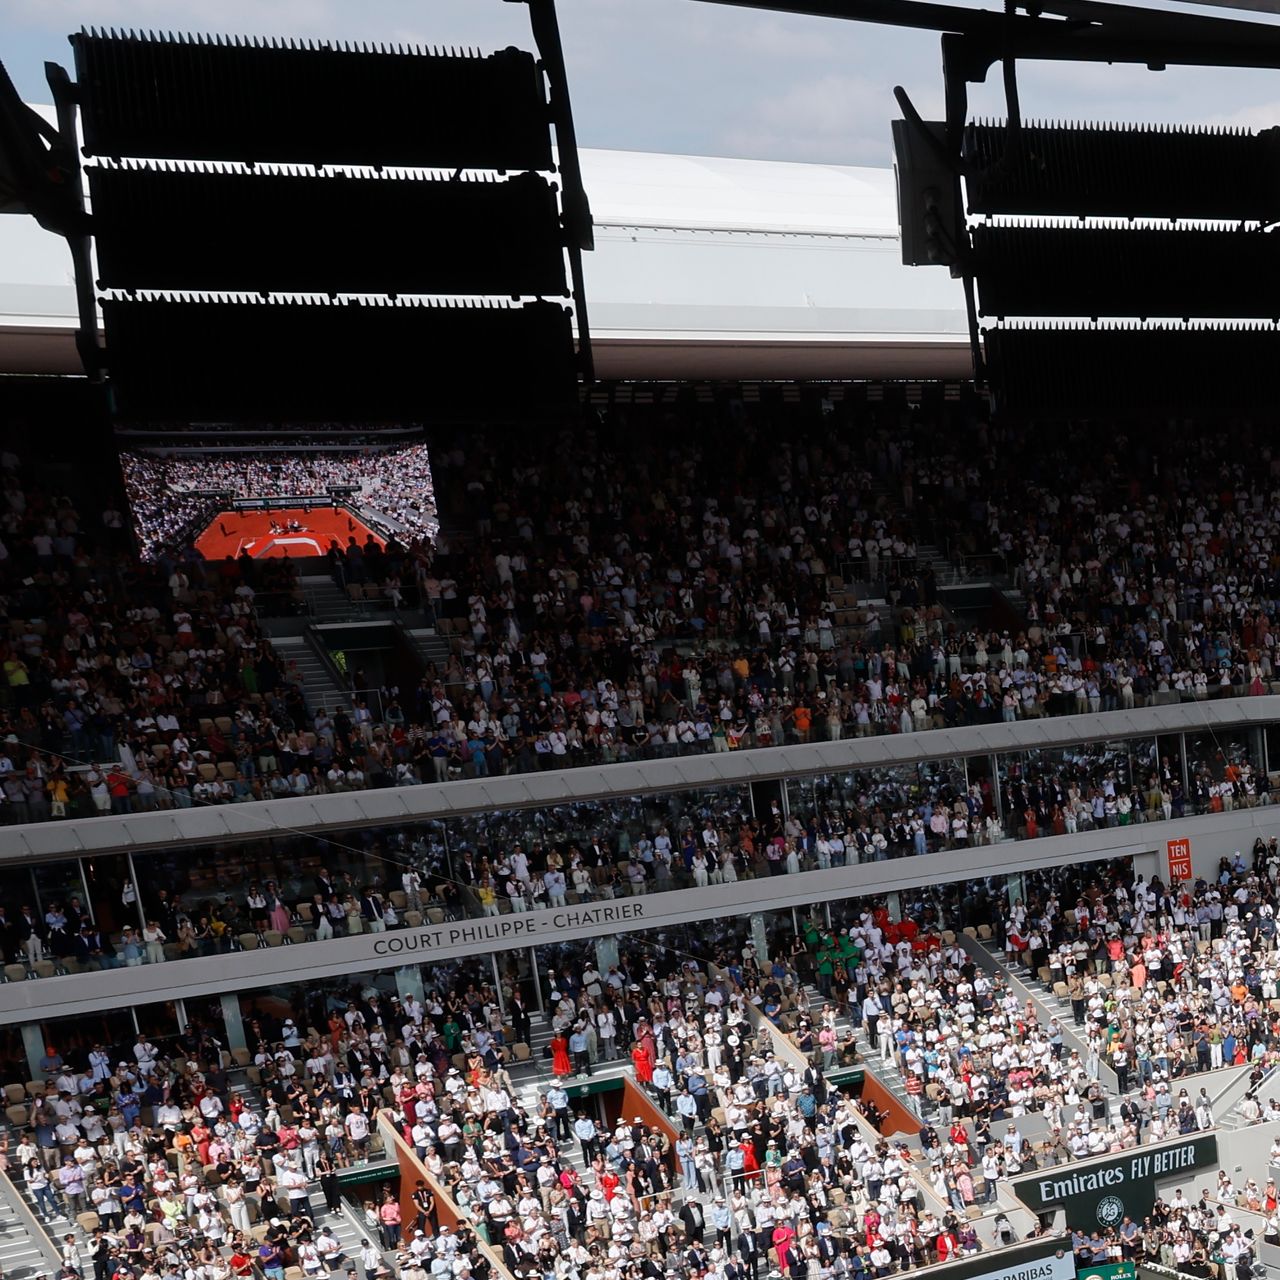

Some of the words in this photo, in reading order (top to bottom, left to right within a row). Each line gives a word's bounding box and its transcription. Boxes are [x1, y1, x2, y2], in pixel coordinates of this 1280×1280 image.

[1170, 844, 1187, 858] TEN
[1172, 863, 1188, 876] NIS
[373, 931, 444, 954] COURT
[449, 918, 536, 944] PHILIPPE
[553, 903, 644, 928] CHATRIER
[1039, 1166, 1125, 1202] Emirates
[1131, 1156, 1150, 1180] FLY
[1153, 1145, 1195, 1174] BETTER
[1110, 1272, 1132, 1280] ROLEX
